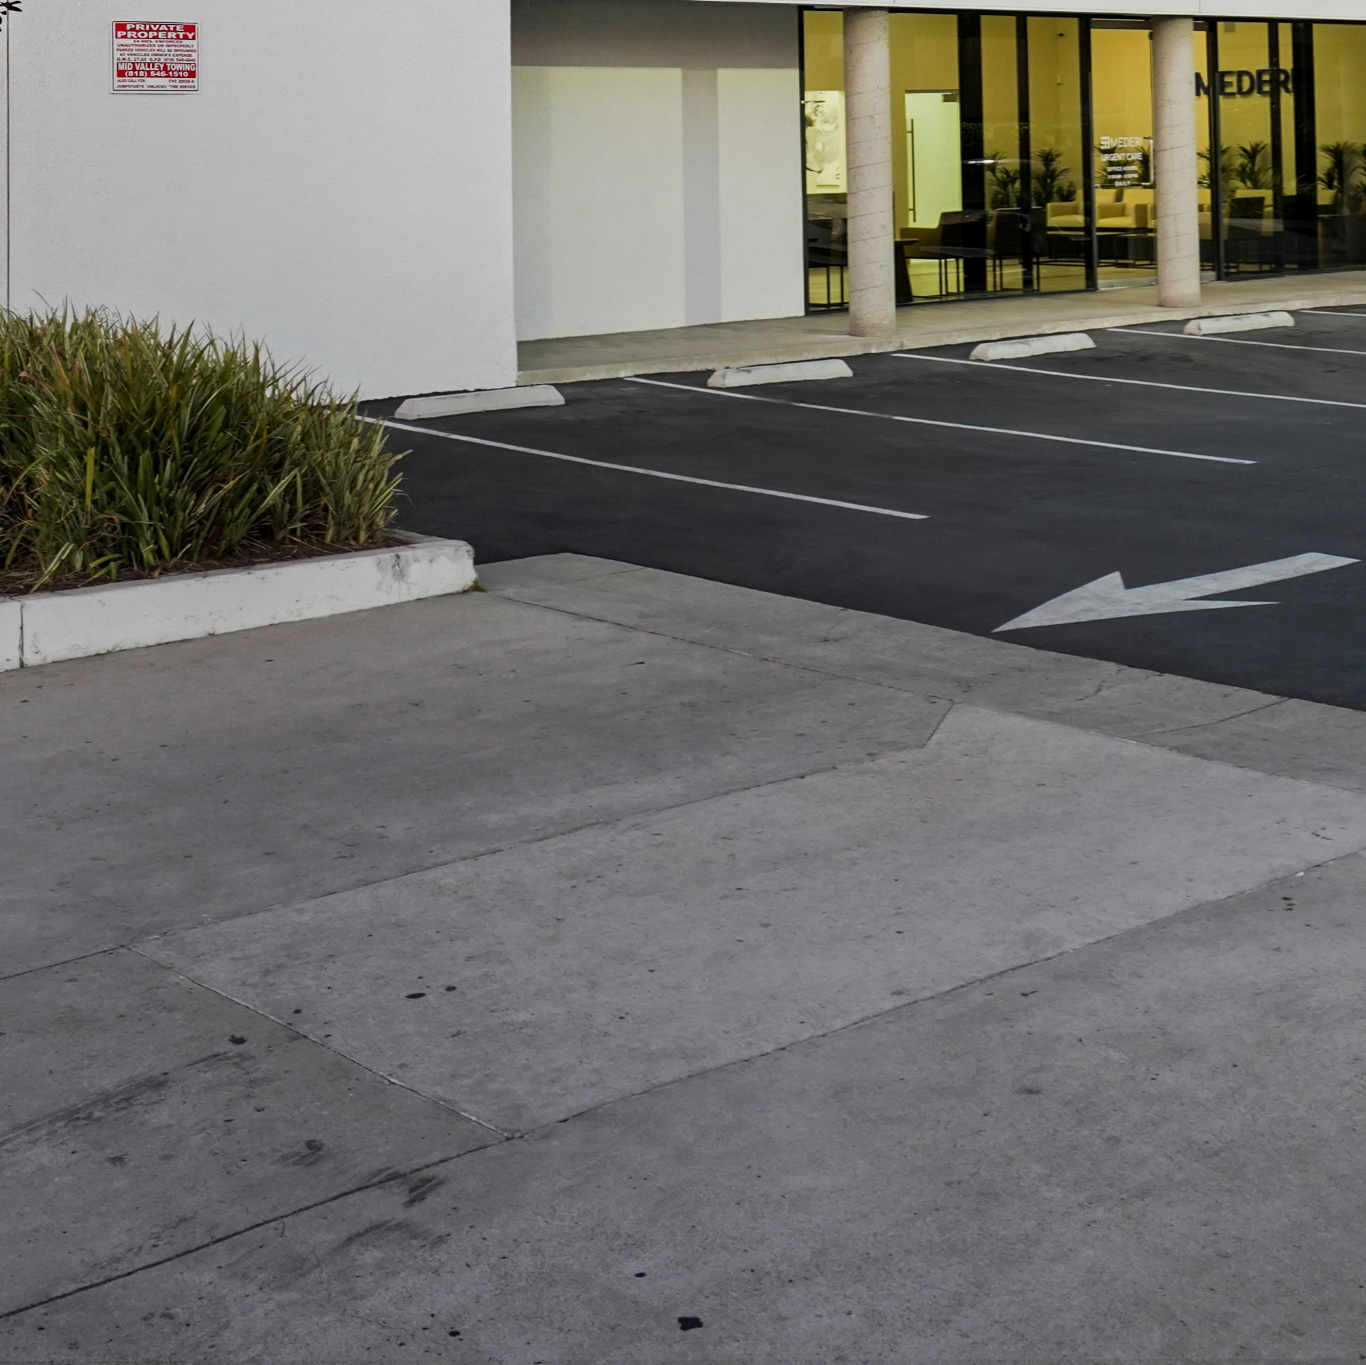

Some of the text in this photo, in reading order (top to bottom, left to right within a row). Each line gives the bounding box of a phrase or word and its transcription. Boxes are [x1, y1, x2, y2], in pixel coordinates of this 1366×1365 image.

[126, 23, 184, 31] PRIVATE
[116, 31, 195, 39] PROPERTY
[117, 63, 195, 71] MID VALLEY TOWING
[1110, 136, 1143, 148] MEDERI
[1101, 152, 1143, 161] URGENT CARE
